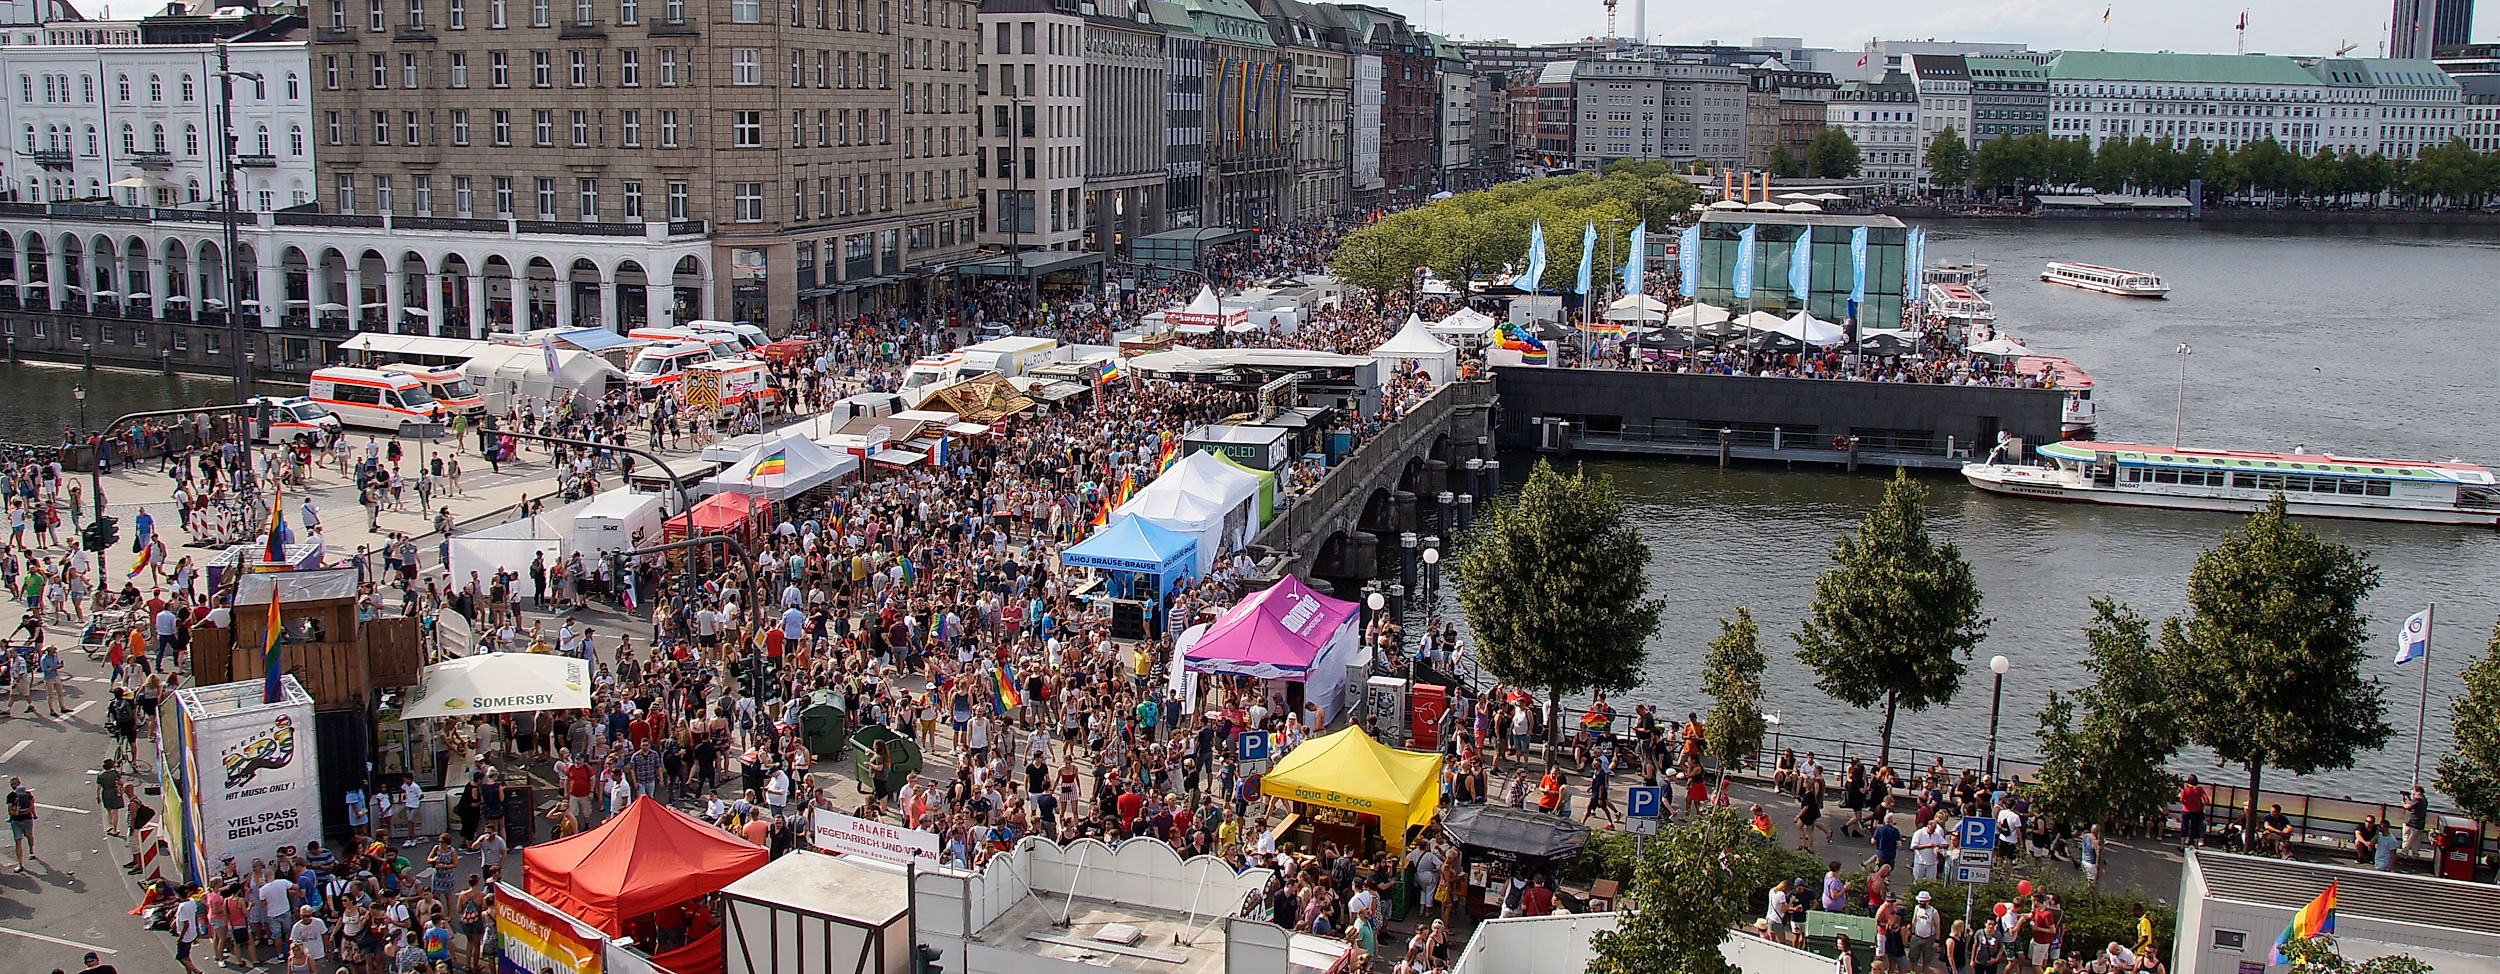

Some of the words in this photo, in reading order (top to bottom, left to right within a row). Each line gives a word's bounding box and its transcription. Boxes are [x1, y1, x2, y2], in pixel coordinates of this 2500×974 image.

[1170, 314, 1225, 326] Shwenkgril
[1023, 351, 1052, 367] ALLROUND
[2011, 487, 2064, 496] ALSTERWASSER
[1069, 555, 1090, 563] AHOJ
[473, 694, 554, 708] SOMERSBY
[221, 726, 276, 756] ENERGY
[1245, 735, 1262, 757] P
[225, 792, 239, 801] HIT
[241, 787, 268, 798] MUSIC
[269, 783, 290, 793] ONLY
[1295, 785, 1322, 800] água
[1326, 791, 1341, 802] de
[1346, 796, 1372, 808] coco
[1635, 790, 1653, 814] P
[228, 814, 257, 828] VIEL
[258, 808, 298, 823] SPASS
[228, 825, 263, 840] BEIM
[265, 818, 299, 833] CSD!
[816, 825, 880, 849] VEGETARISCH
[881, 841, 903, 853] UND
[852, 821, 901, 840] FALAFEL
[1966, 821, 1986, 845] P
[498, 904, 538, 936] WELCOME
[538, 924, 550, 941] TO
